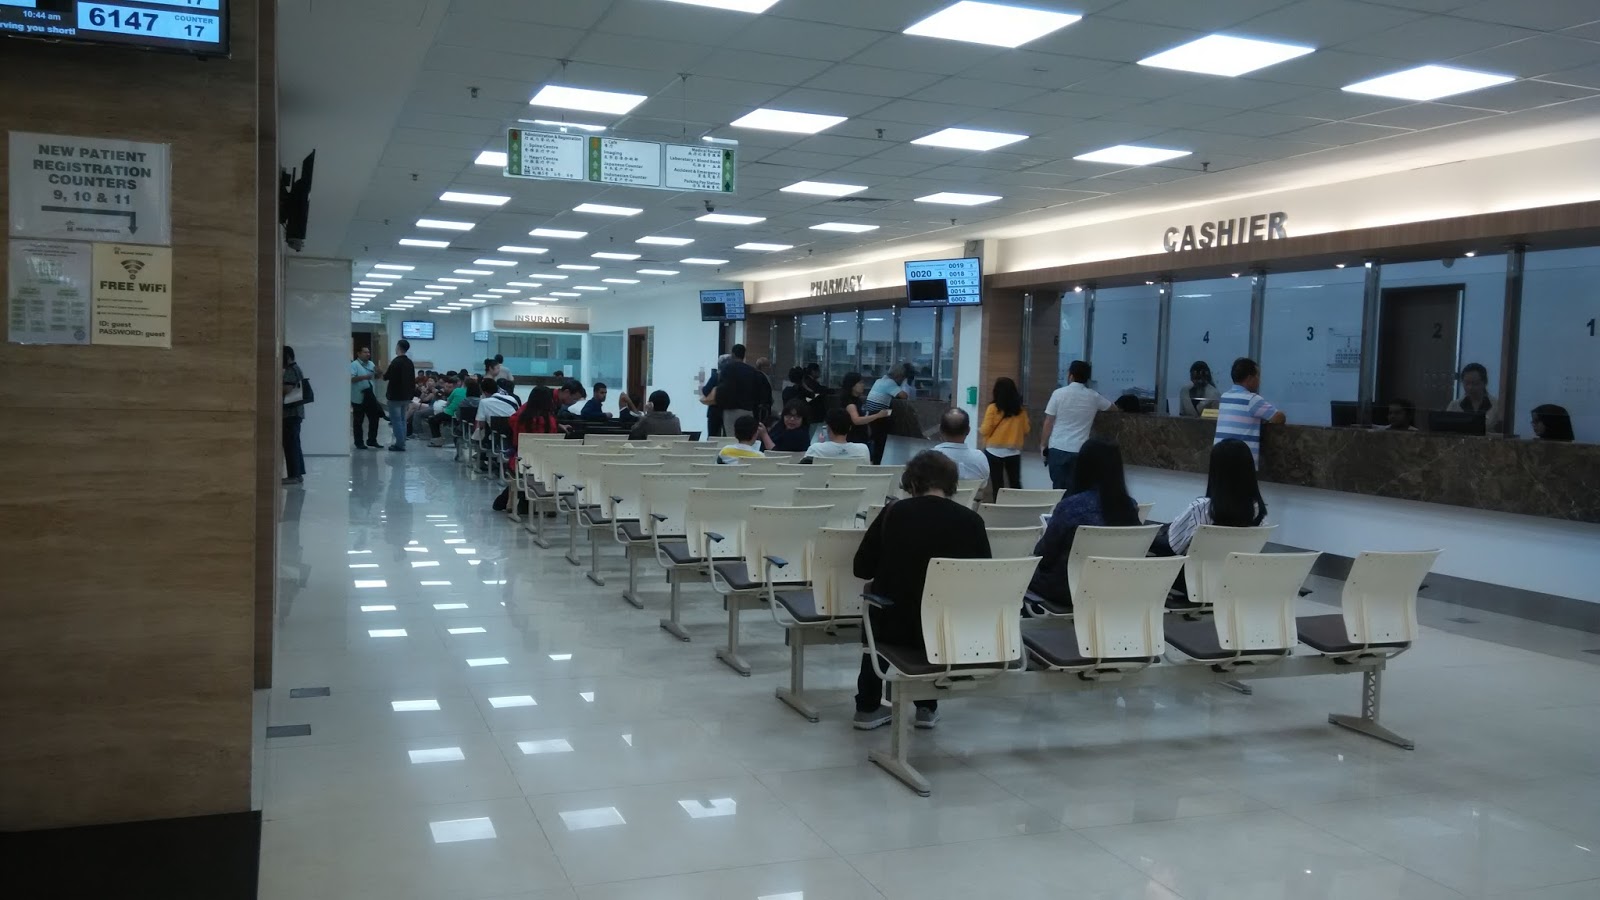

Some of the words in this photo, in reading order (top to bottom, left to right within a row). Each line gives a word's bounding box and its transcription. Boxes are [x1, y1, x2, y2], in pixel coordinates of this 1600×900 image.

[23, 10, 46, 19] 10:44
[89, 7, 159, 31] 6147
[174, 15, 214, 24] COUNTER
[184, 24, 204, 37] 17
[38, 144, 74, 157] NEW
[80, 148, 146, 162] PATIENT
[33, 159, 152, 178] REGISTRATION
[48, 174, 137, 190] COUNTERS
[53, 190, 67, 202] 9,
[74, 191, 91, 202] 10
[97, 193, 107, 203] &
[115, 194, 130, 204] 11
[1163, 211, 1288, 252] CASHIER
[100, 281, 134, 291] FREE
[138, 283, 166, 292] WiFi
[811, 275, 863, 296] PHARMACY
[515, 315, 570, 323] INSURANCE
[1306, 326, 1314, 341] 3
[1432, 322, 1443, 338] 2
[1586, 318, 1596, 336] 1
[1122, 333, 1127, 344] 5
[1203, 331, 1209, 343] 4
